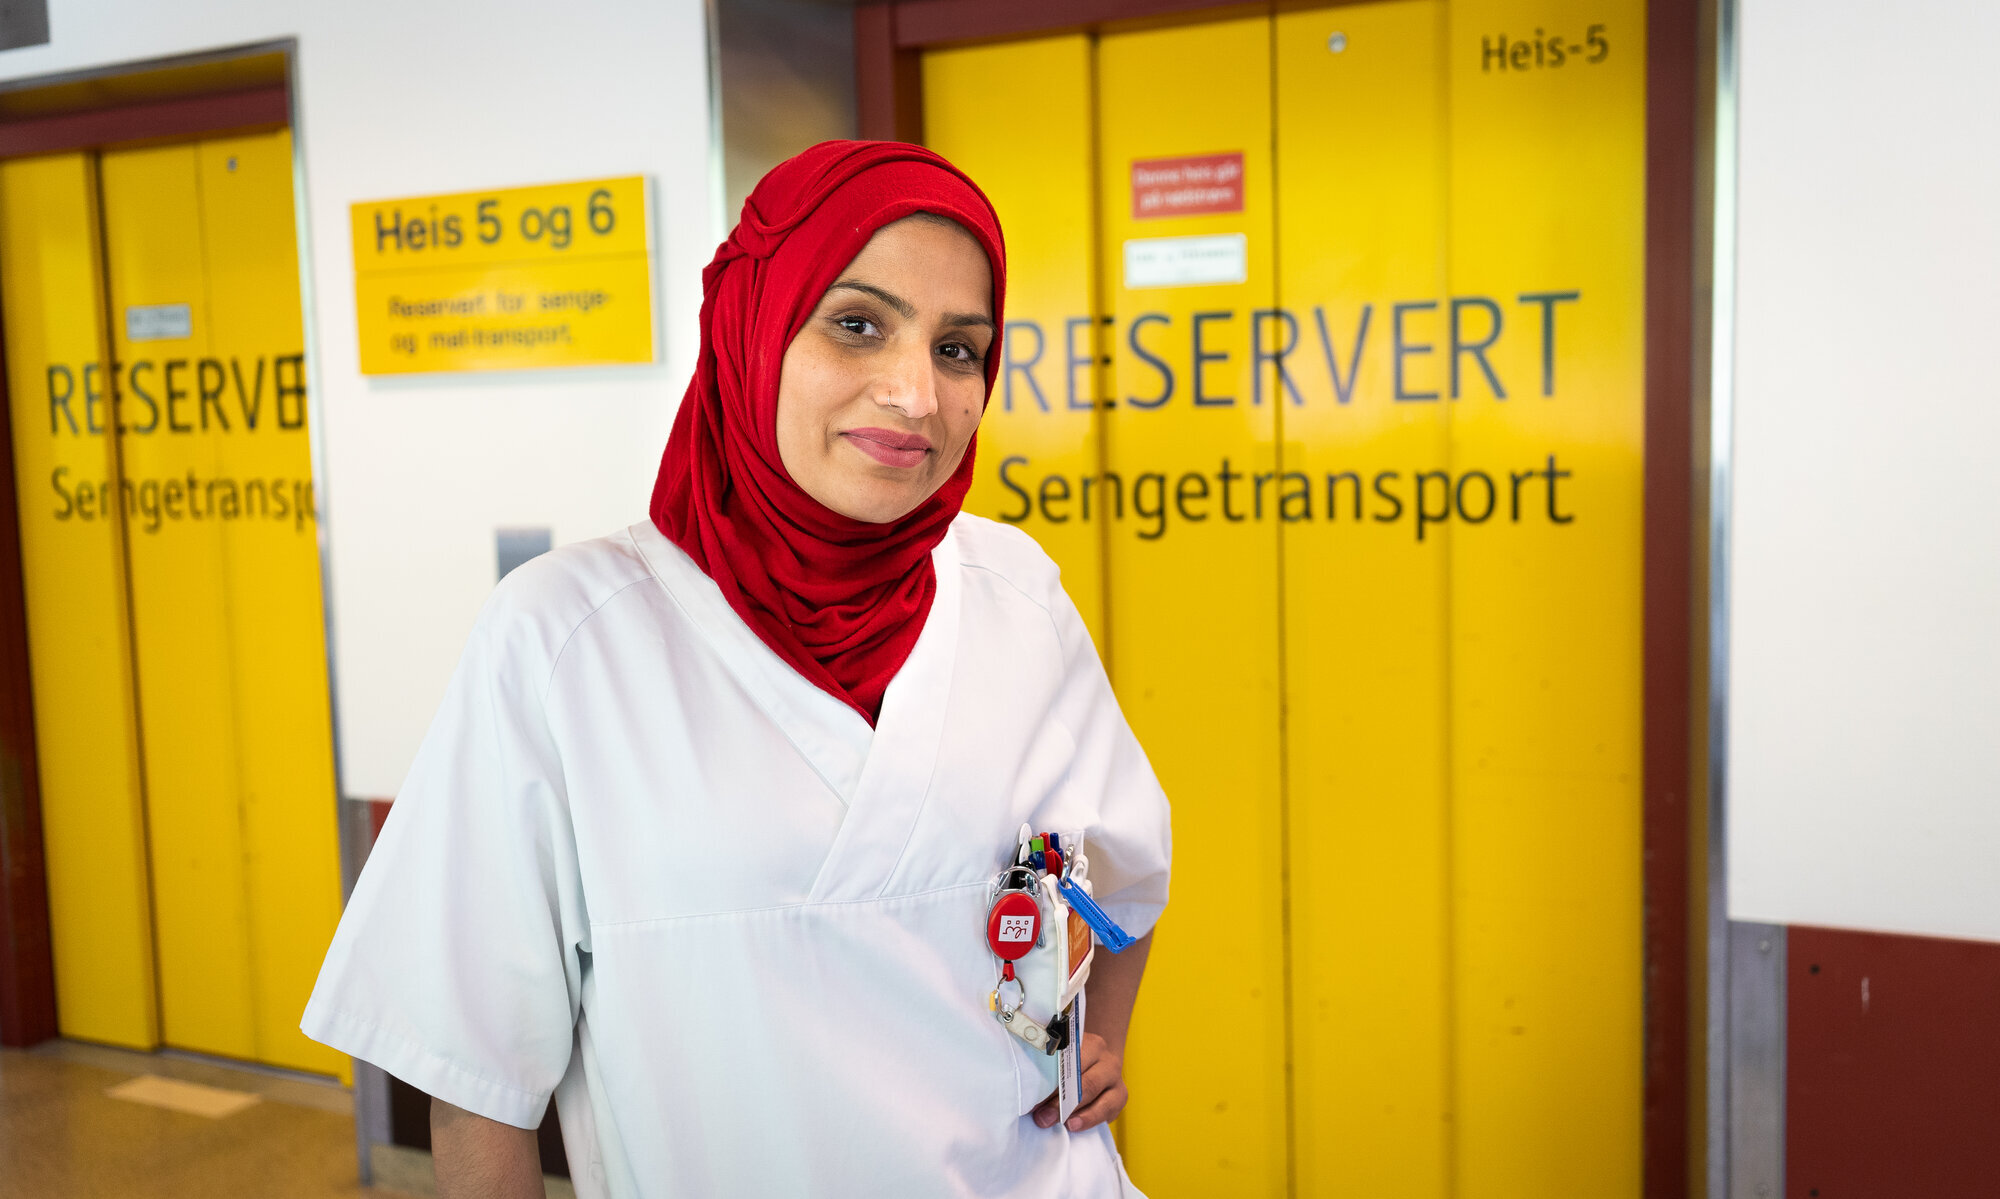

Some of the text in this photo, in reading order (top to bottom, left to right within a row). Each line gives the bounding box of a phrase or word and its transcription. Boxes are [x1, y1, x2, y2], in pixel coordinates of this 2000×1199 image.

[1482, 25, 1609, 73] Heis-5
[374, 188, 615, 254] Heis 5 og 6
[388, 295, 487, 321] Reservert
[390, 333, 418, 357] og
[1001, 290, 1581, 414] RESERVERT
